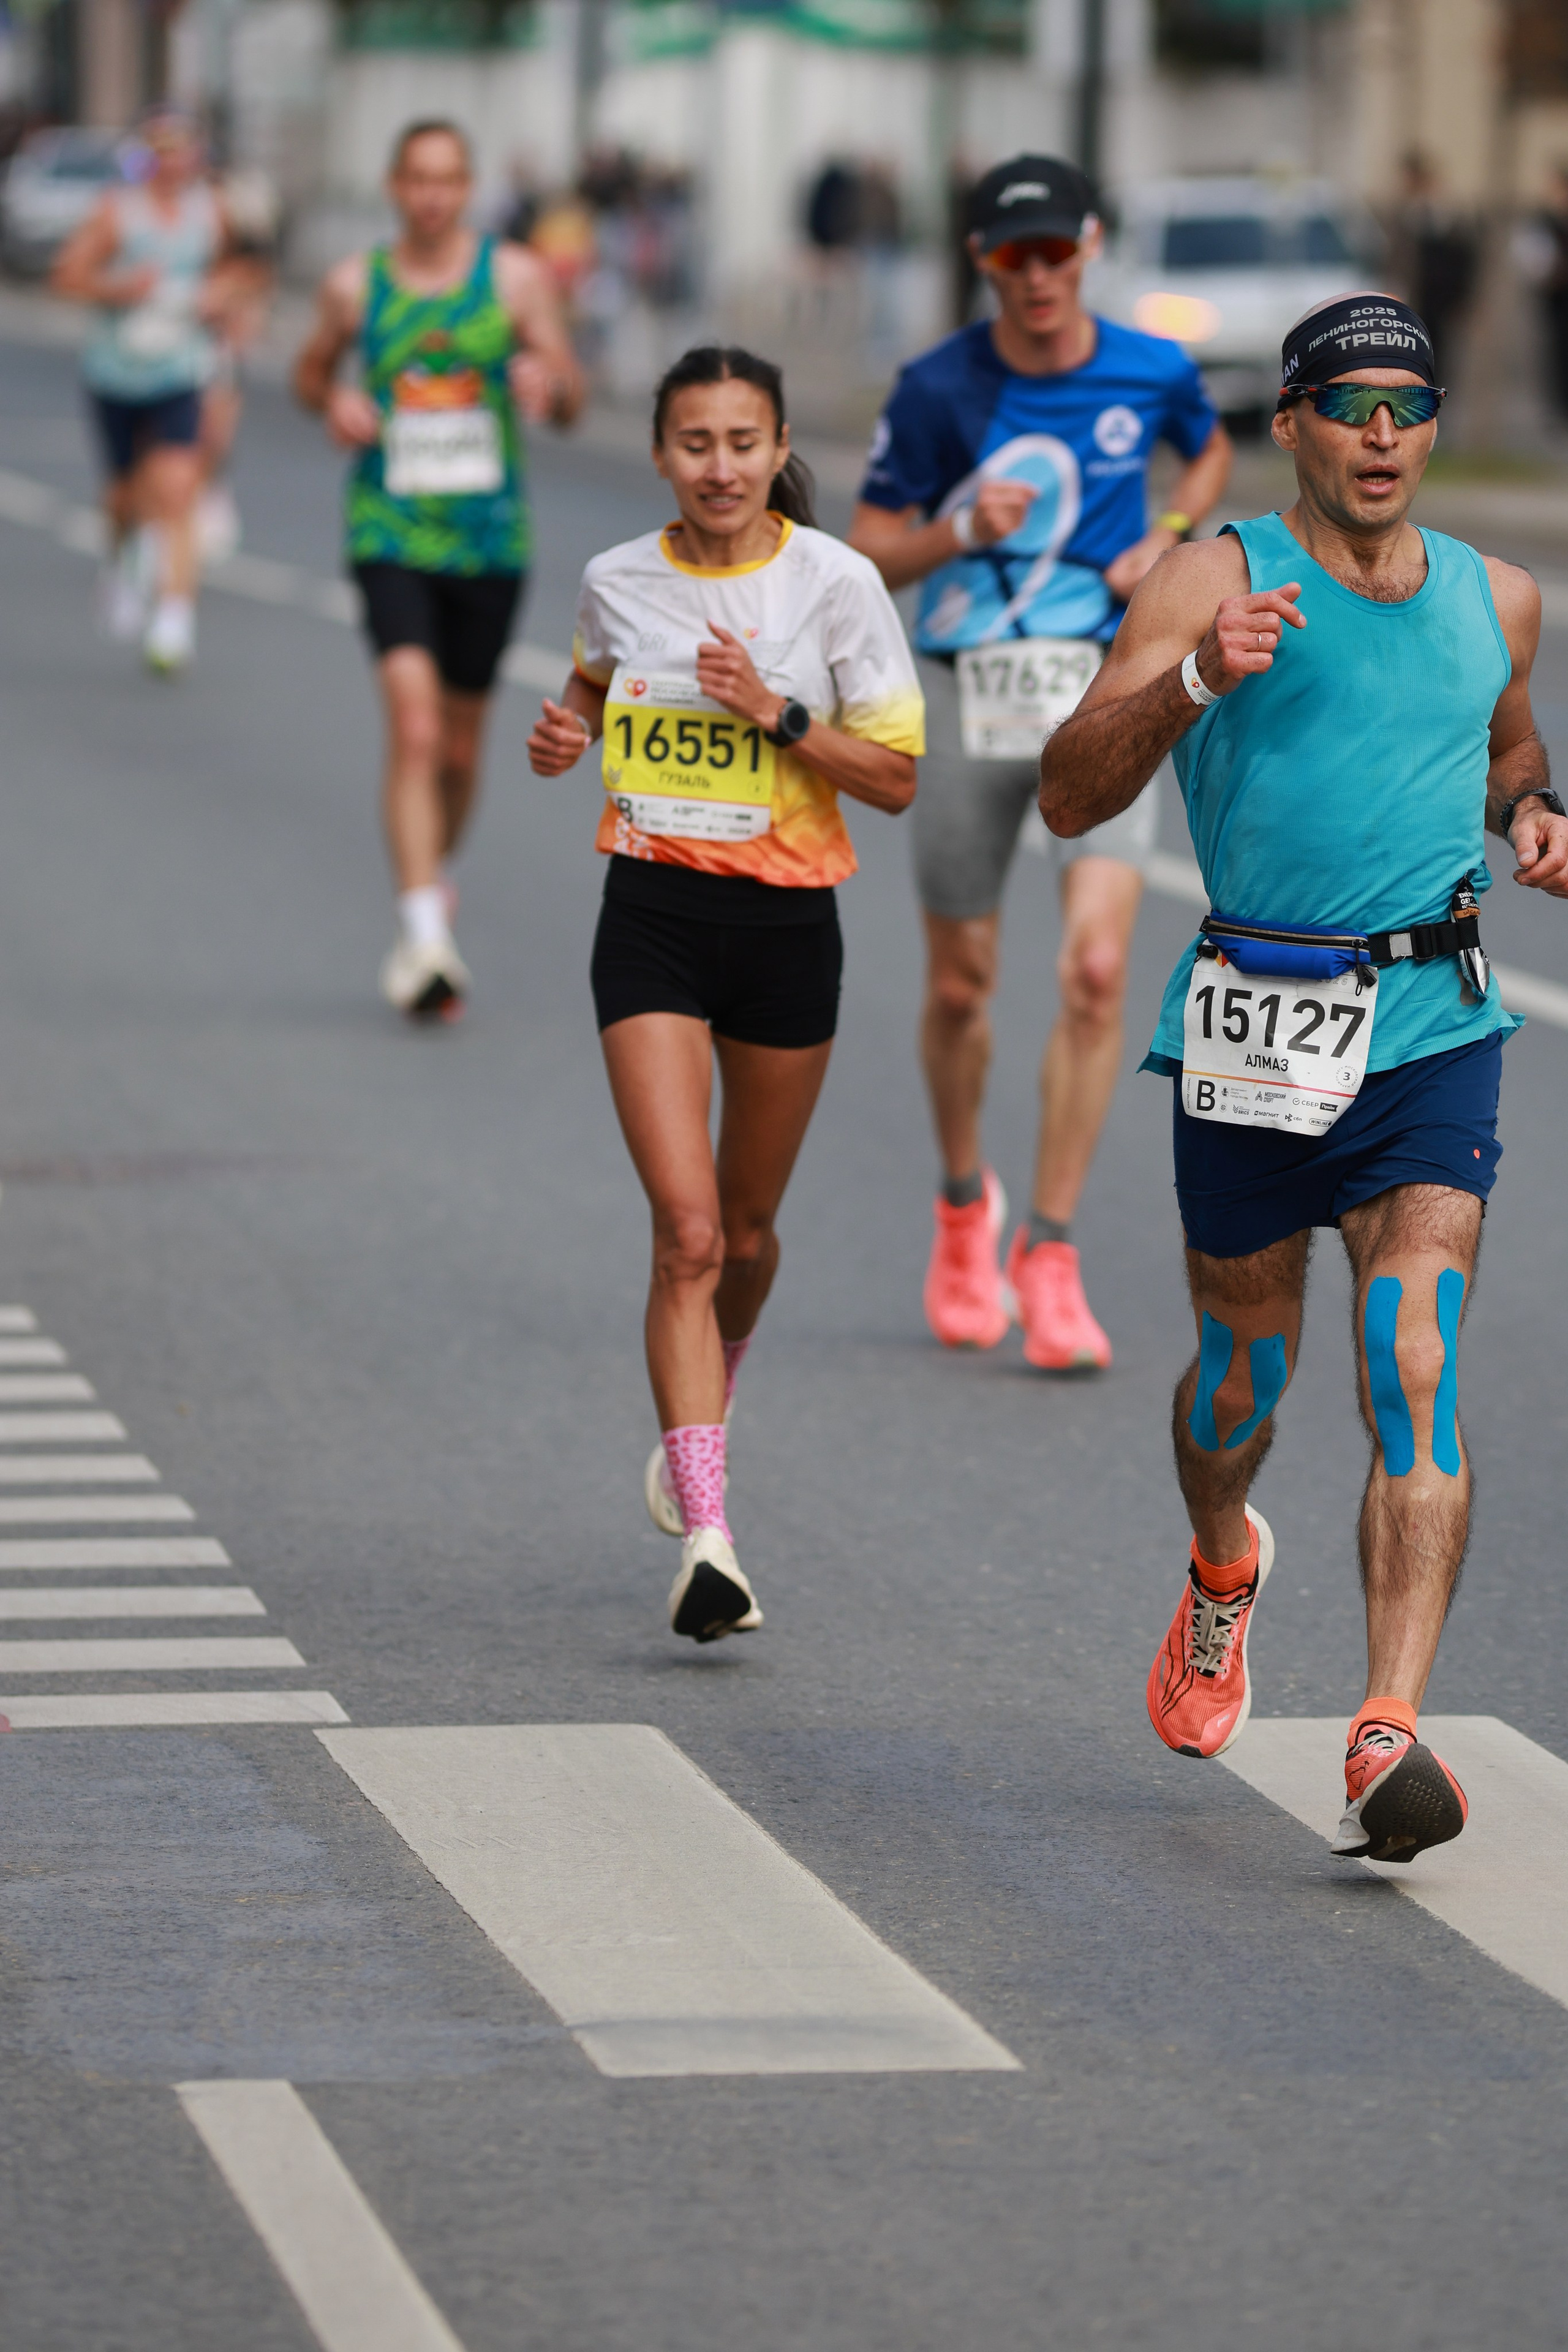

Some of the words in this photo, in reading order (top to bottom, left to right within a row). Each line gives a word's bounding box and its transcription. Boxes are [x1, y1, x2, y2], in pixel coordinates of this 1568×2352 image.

[1350, 307, 1397, 317] 2025
[1335, 330, 1416, 351] ТРЕЙЛ
[971, 652, 1091, 697] 17629
[615, 714, 760, 772] 16551
[658, 771, 710, 788] ГУЗАЛЬ
[1196, 985, 1366, 1058] 15127
[1245, 1054, 1289, 1072] АЛМАЗ
[1343, 1072, 1351, 1080] 3
